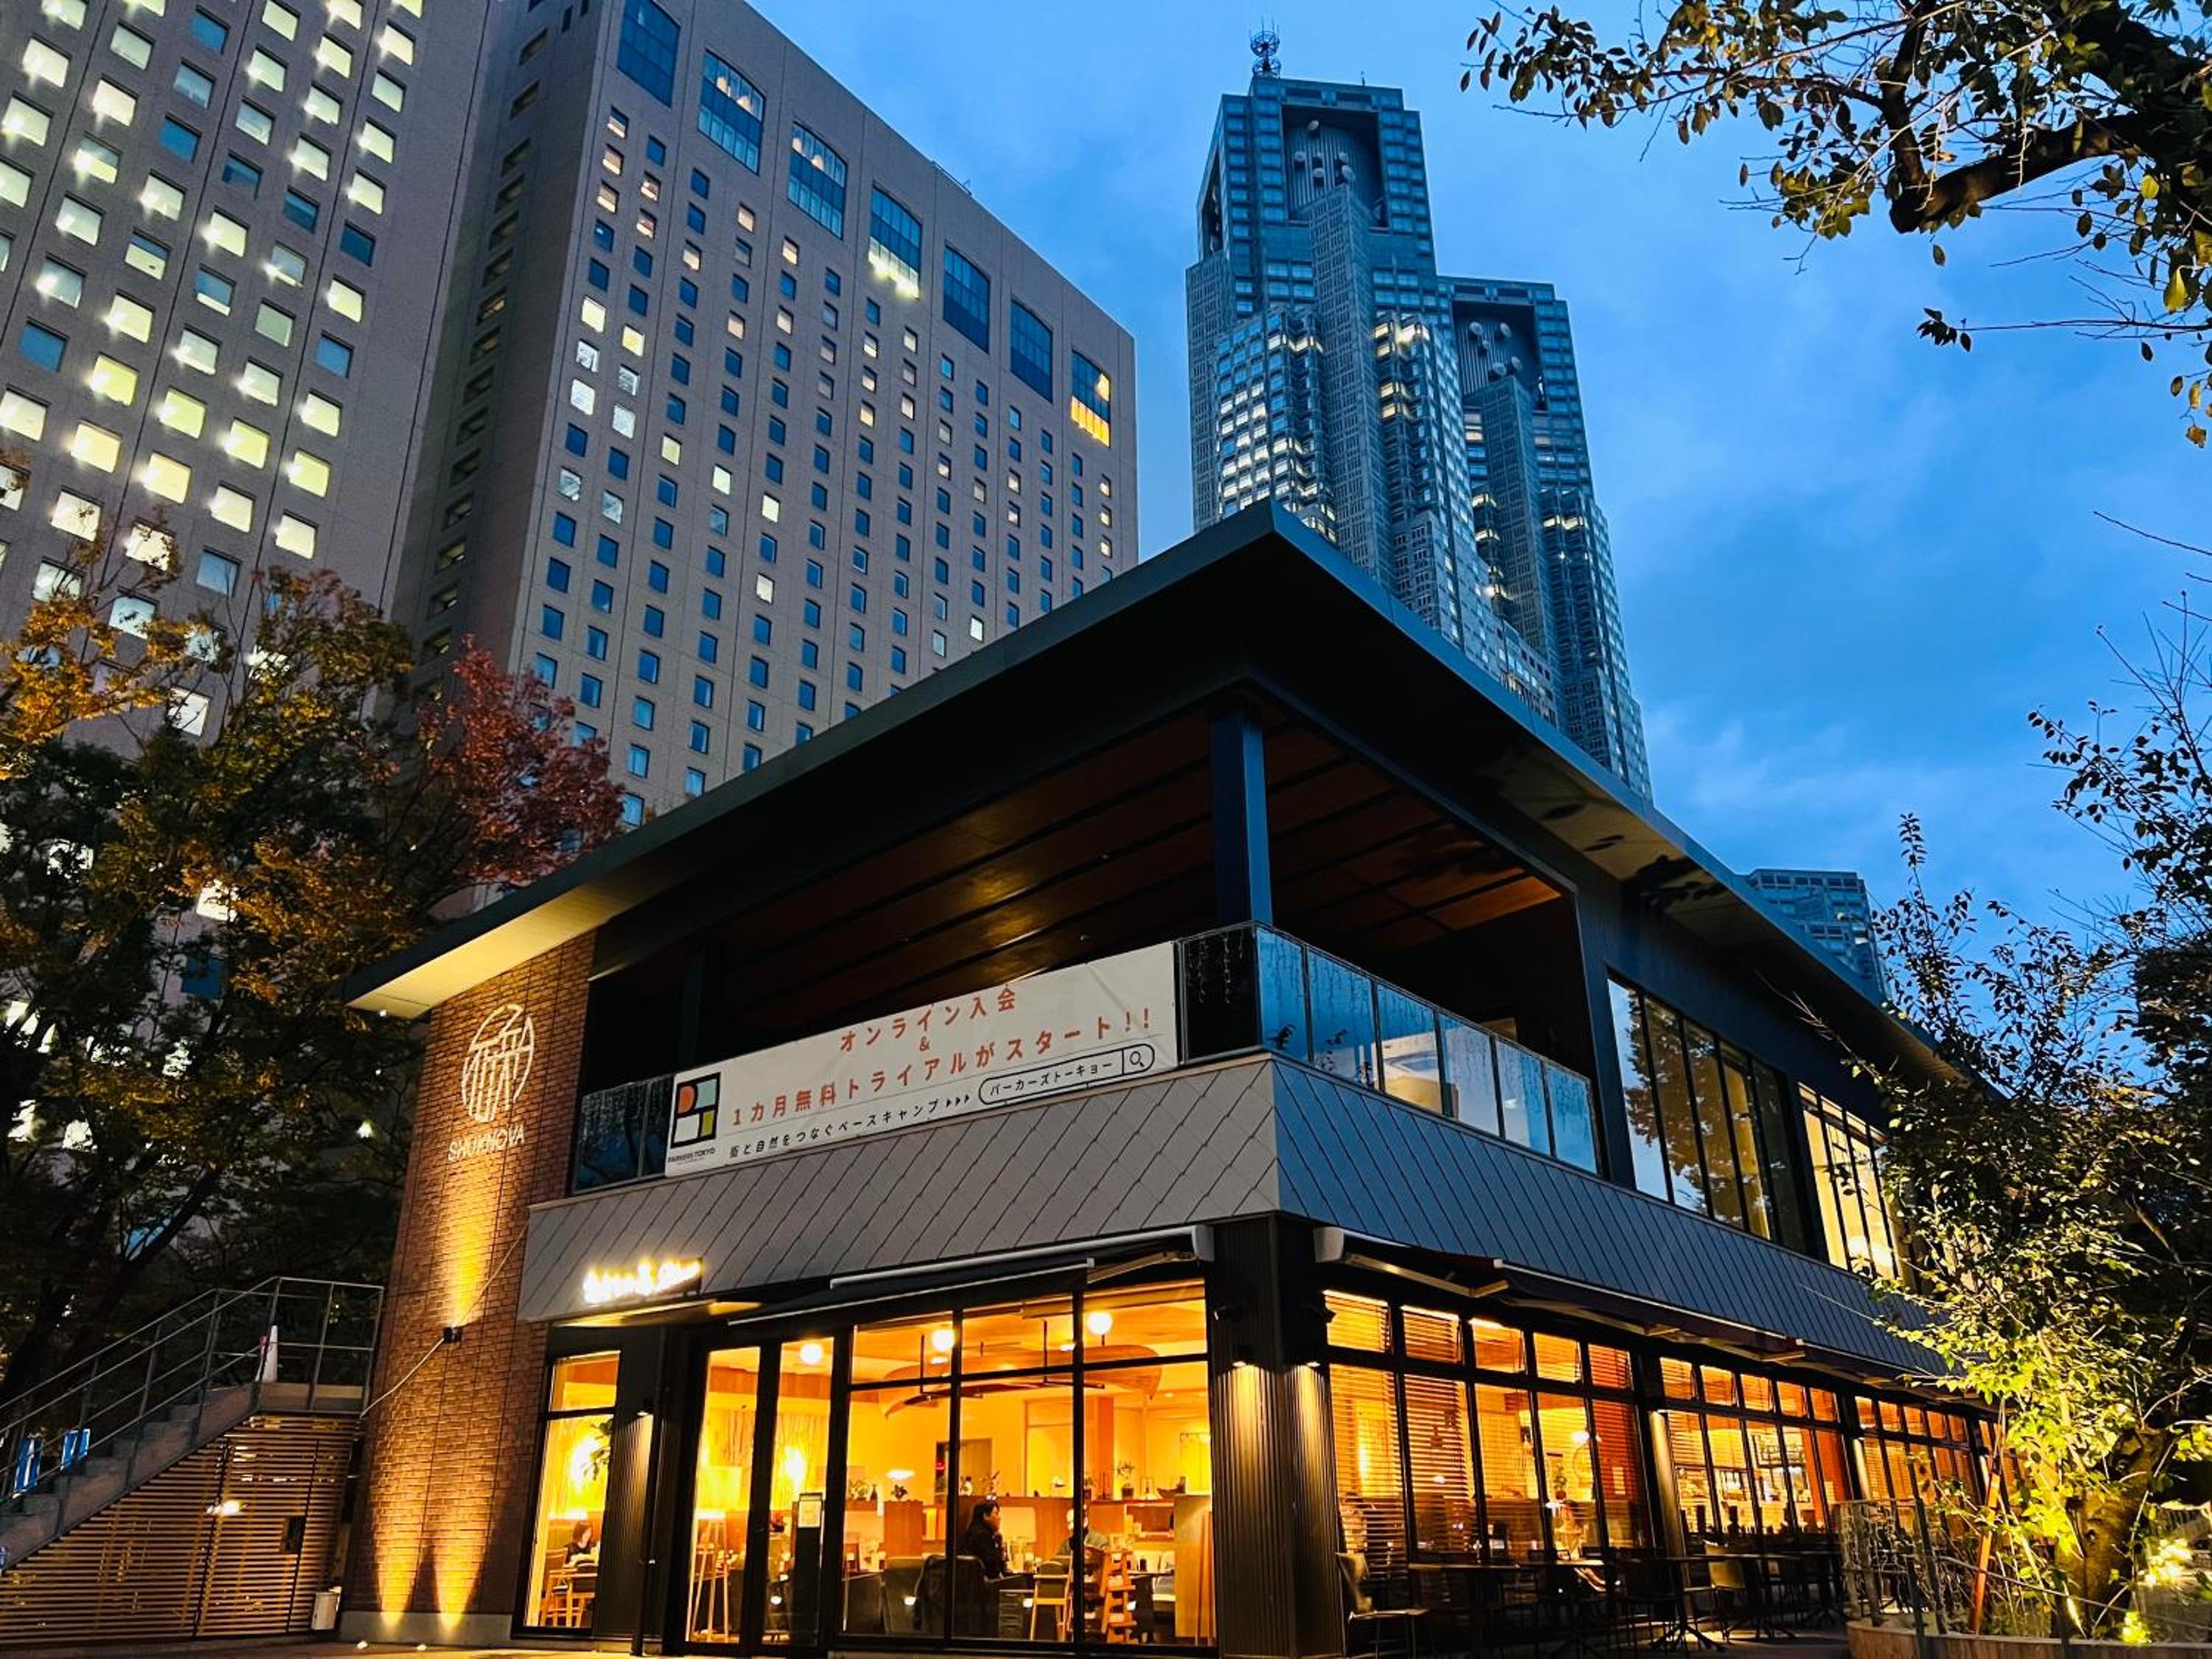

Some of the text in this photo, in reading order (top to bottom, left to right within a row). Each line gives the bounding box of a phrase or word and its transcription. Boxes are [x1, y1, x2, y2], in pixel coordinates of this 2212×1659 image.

[841, 987, 1015, 1052] オンライン入会
[919, 1035, 931, 1051] &
[990, 1061, 1113, 1096] パーカーズトーキョー
